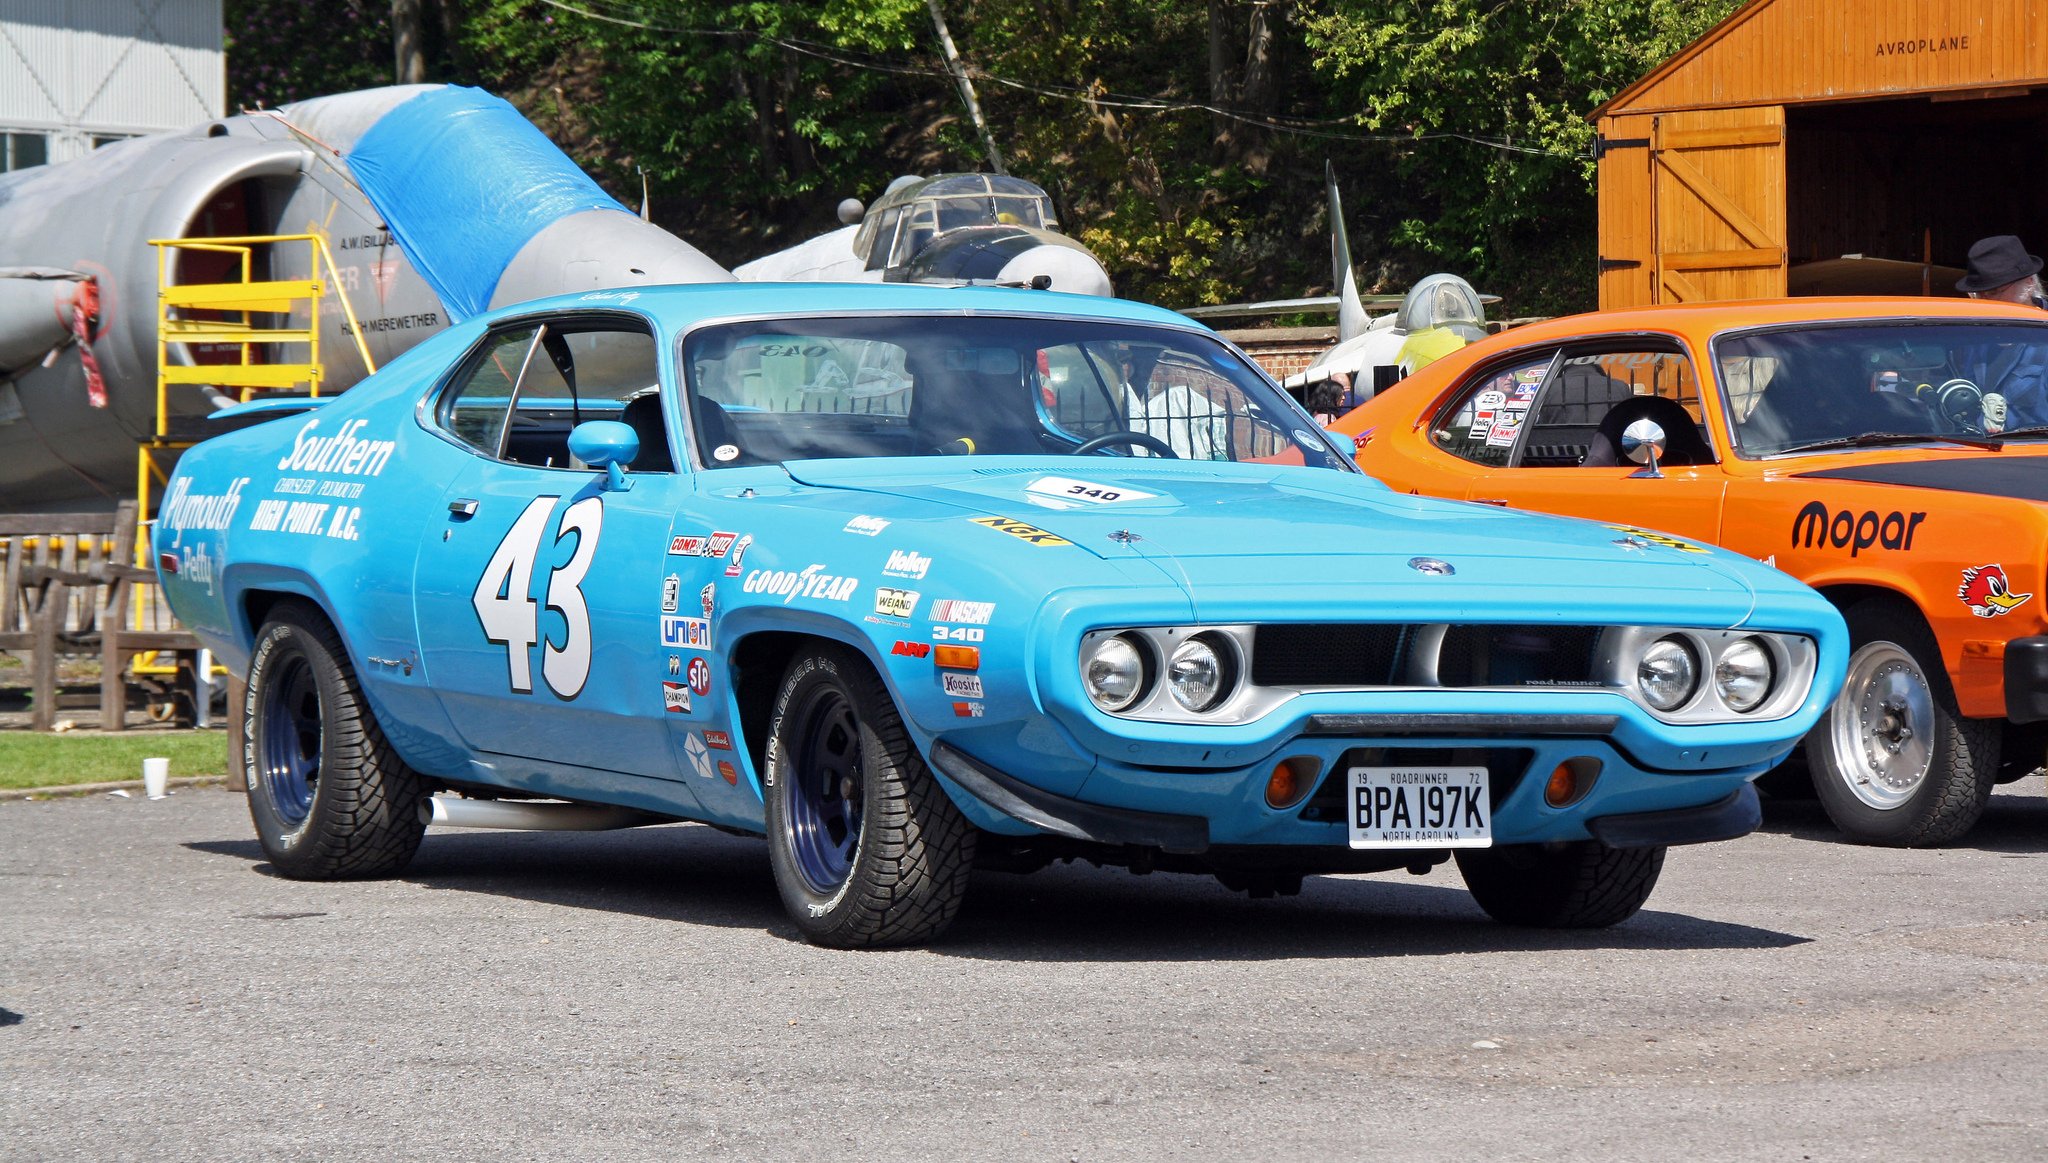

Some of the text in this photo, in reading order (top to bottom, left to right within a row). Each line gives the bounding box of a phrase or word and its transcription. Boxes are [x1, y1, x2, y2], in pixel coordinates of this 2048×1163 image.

[1876, 36, 1968, 56] AVROPLANE
[369, 313, 438, 332] MEREWETHER
[277, 418, 396, 477] Southern
[1067, 485, 1121, 501] 340
[162, 476, 251, 549] Plymouth
[249, 499, 288, 531] HIGH
[977, 518, 1064, 544] NGK
[1792, 500, 1928, 558] Mopar
[671, 538, 698, 551] COMP
[884, 549, 933, 578] Holley
[471, 495, 604, 702] 43
[879, 596, 912, 611] WEIAND
[949, 600, 992, 625] NASCAR
[932, 625, 985, 642] 340
[890, 640, 931, 659] ARP
[689, 660, 708, 690] STP
[945, 675, 980, 692] Hoosier
[665, 691, 689, 704] CHAMPION
[1357, 772, 1480, 785] 19 ROADRUNNER 72
[1355, 786, 1412, 829] BPA
[1382, 830, 1460, 843] NORTH CAROLINA
